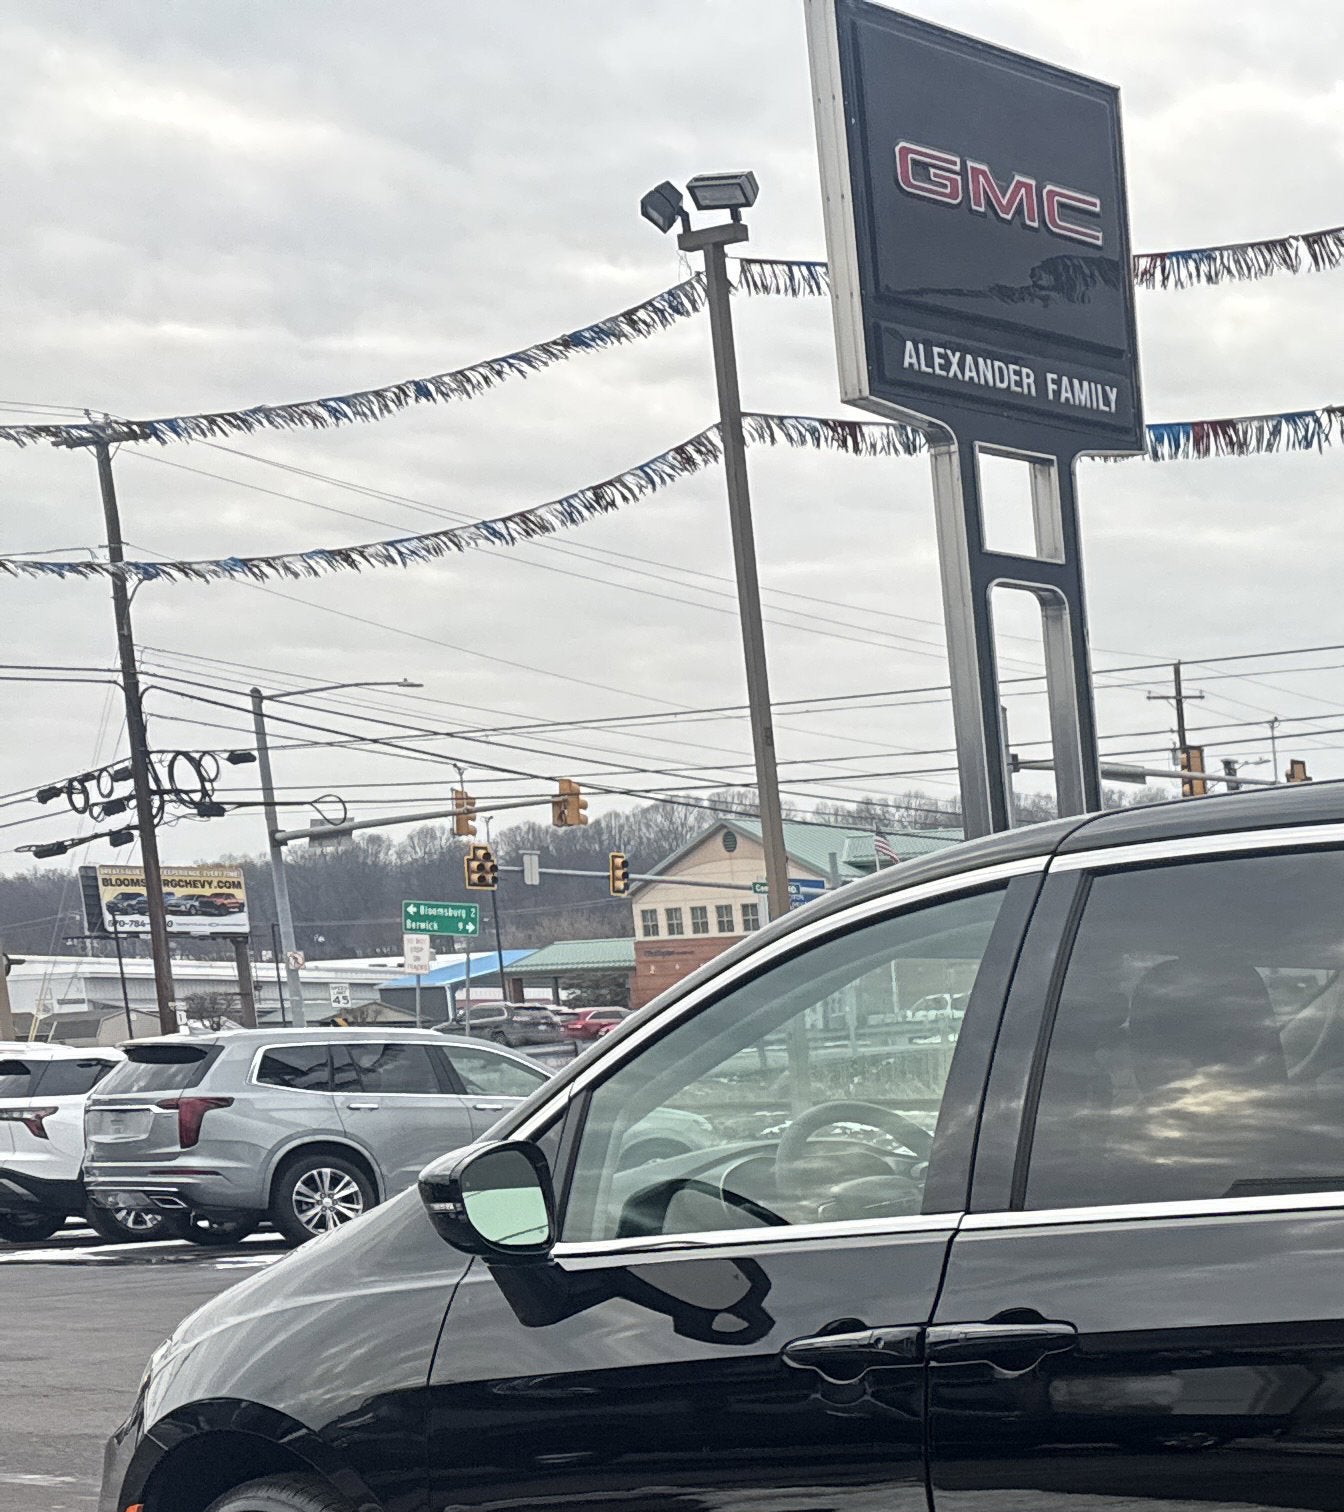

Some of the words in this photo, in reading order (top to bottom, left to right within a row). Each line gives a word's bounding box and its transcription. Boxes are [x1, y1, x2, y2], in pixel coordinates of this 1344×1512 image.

[895, 140, 1103, 246] GMC
[903, 340, 1037, 398] ALEXANDER
[1046, 372, 1118, 414] FAMILY
[102, 878, 242, 890] BLOOMSRGCHEVY.COM
[420, 905, 466, 919] Bloomsburg
[470, 908, 476, 918] 2
[406, 919, 438, 930] Berwick
[333, 996, 349, 1004] 45
